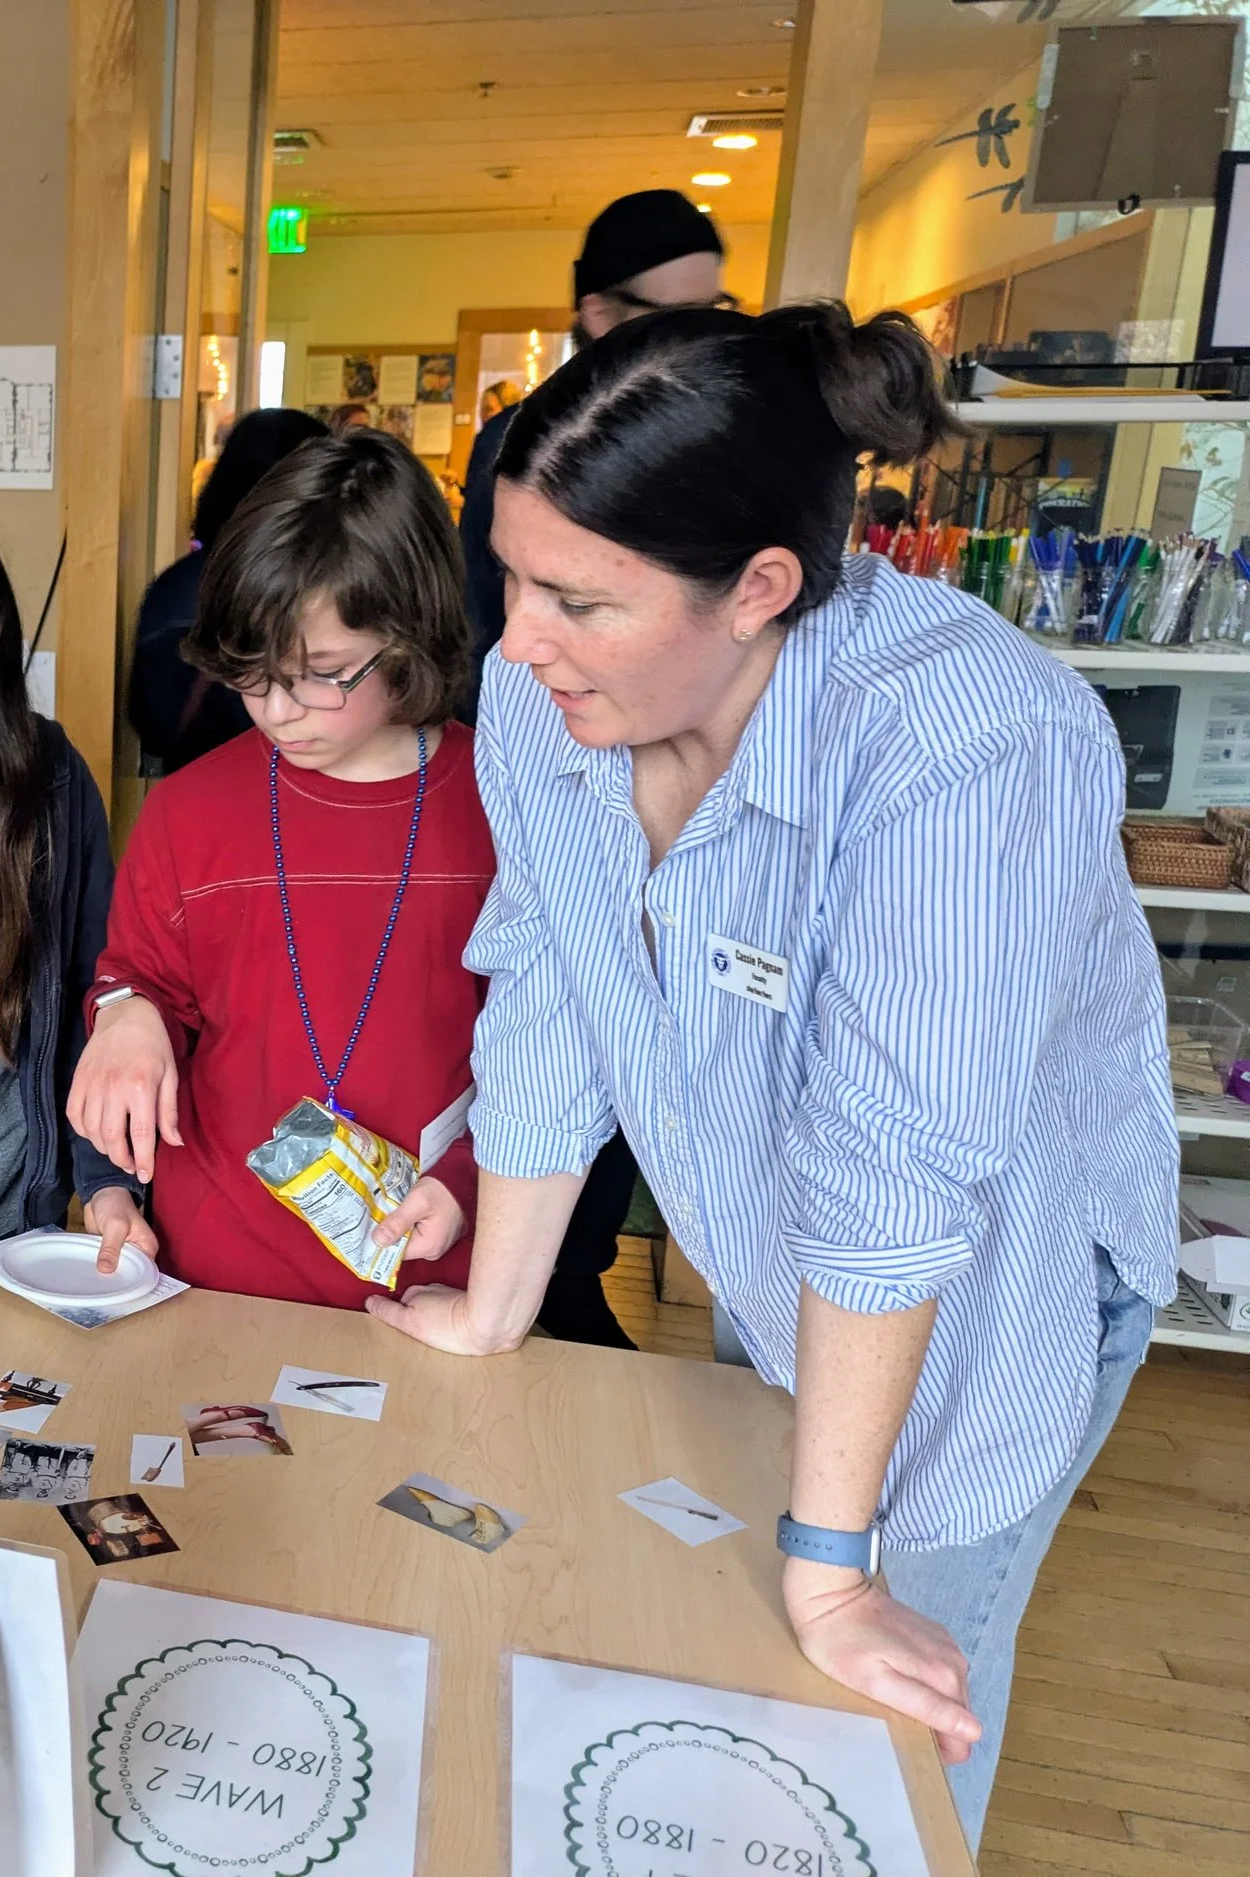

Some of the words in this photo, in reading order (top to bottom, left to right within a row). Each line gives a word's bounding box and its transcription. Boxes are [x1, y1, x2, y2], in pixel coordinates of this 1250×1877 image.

[316, 1172, 334, 1188] Facts
[334, 1185, 346, 1197] 160
[141, 1720, 214, 1755] 1920
[253, 1742, 327, 1777] 1880
[145, 1766, 170, 1792] 2
[174, 1771, 286, 1820] WAVE
[616, 1814, 695, 1853] 1880
[744, 1839, 824, 1877] 1820
